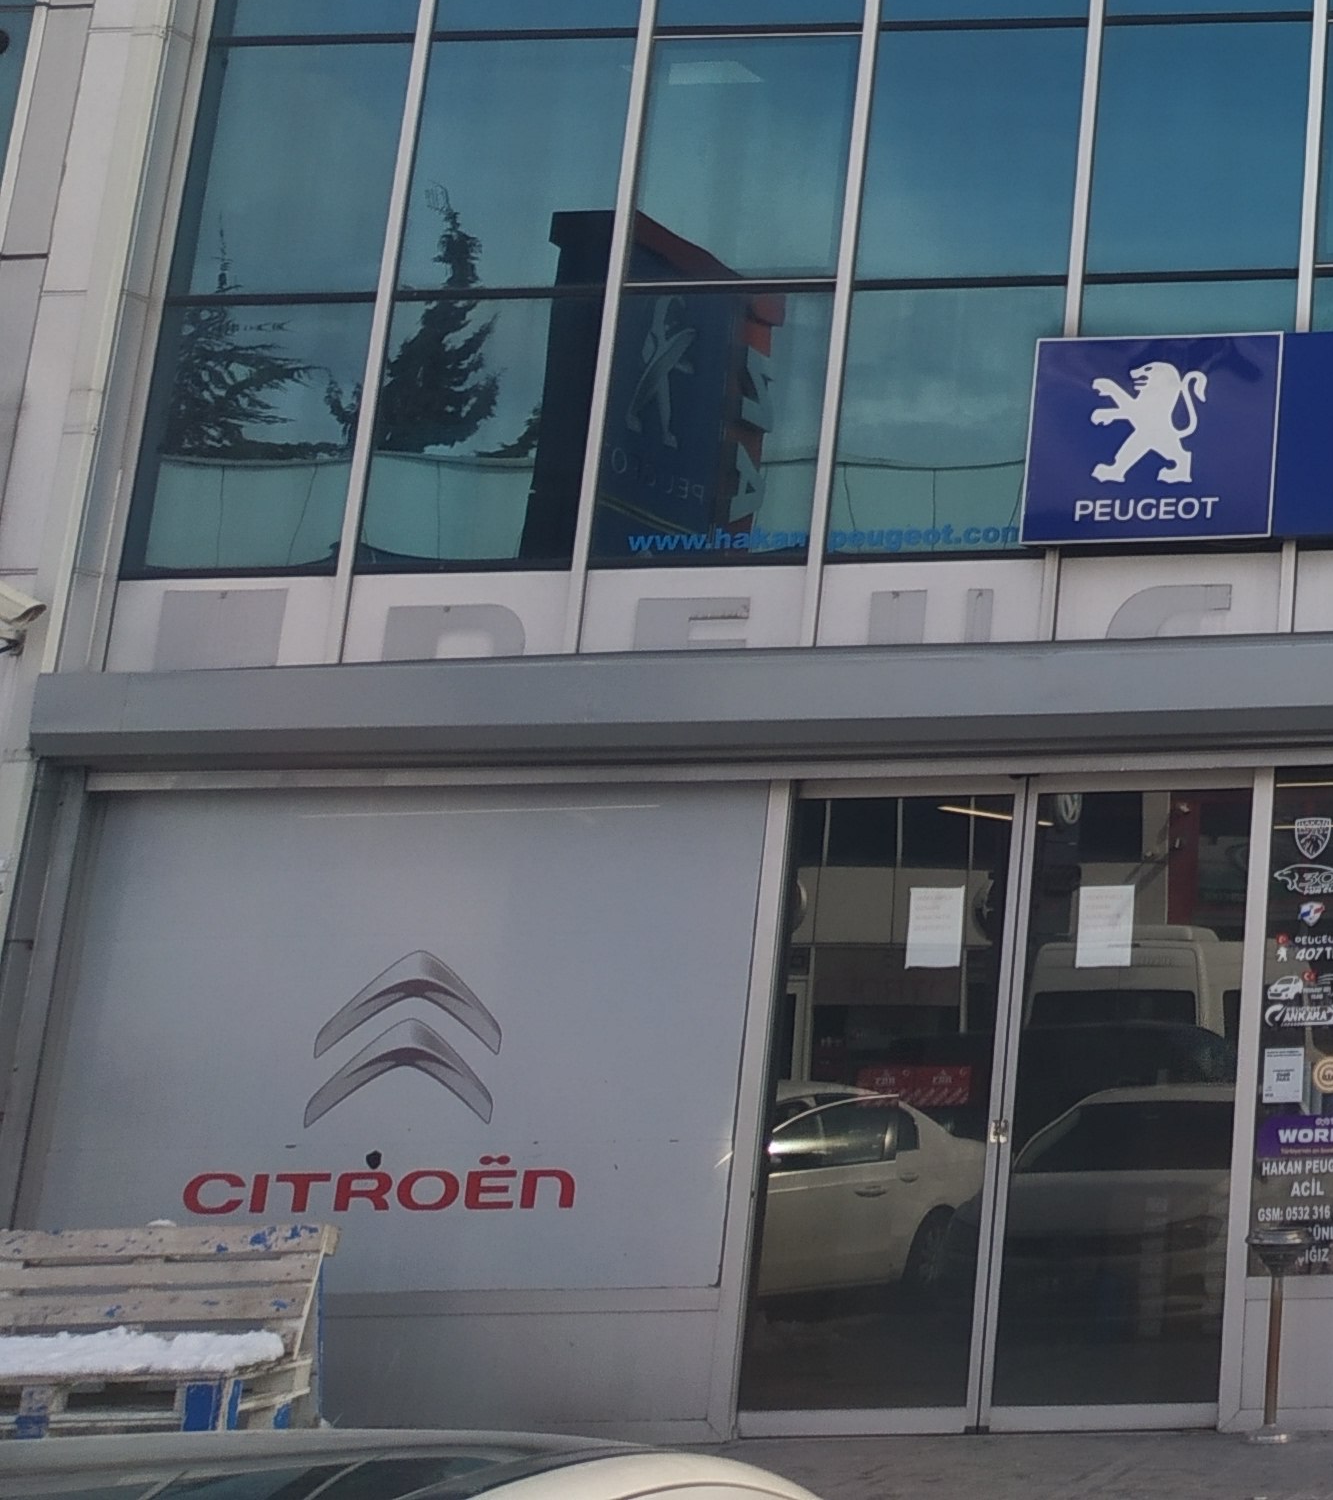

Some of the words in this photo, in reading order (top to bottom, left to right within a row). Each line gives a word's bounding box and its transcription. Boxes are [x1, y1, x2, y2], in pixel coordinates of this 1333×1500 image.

[1074, 496, 1219, 522] PEUGEOT
[1295, 947, 1323, 961] 407
[1262, 1160, 1302, 1176] HAKAN
[1290, 1177, 1325, 1197] ACİL
[1257, 1206, 1283, 1222] GSM:
[1285, 1205, 1310, 1221] 0532
[1312, 1205, 1331, 1219] 316
